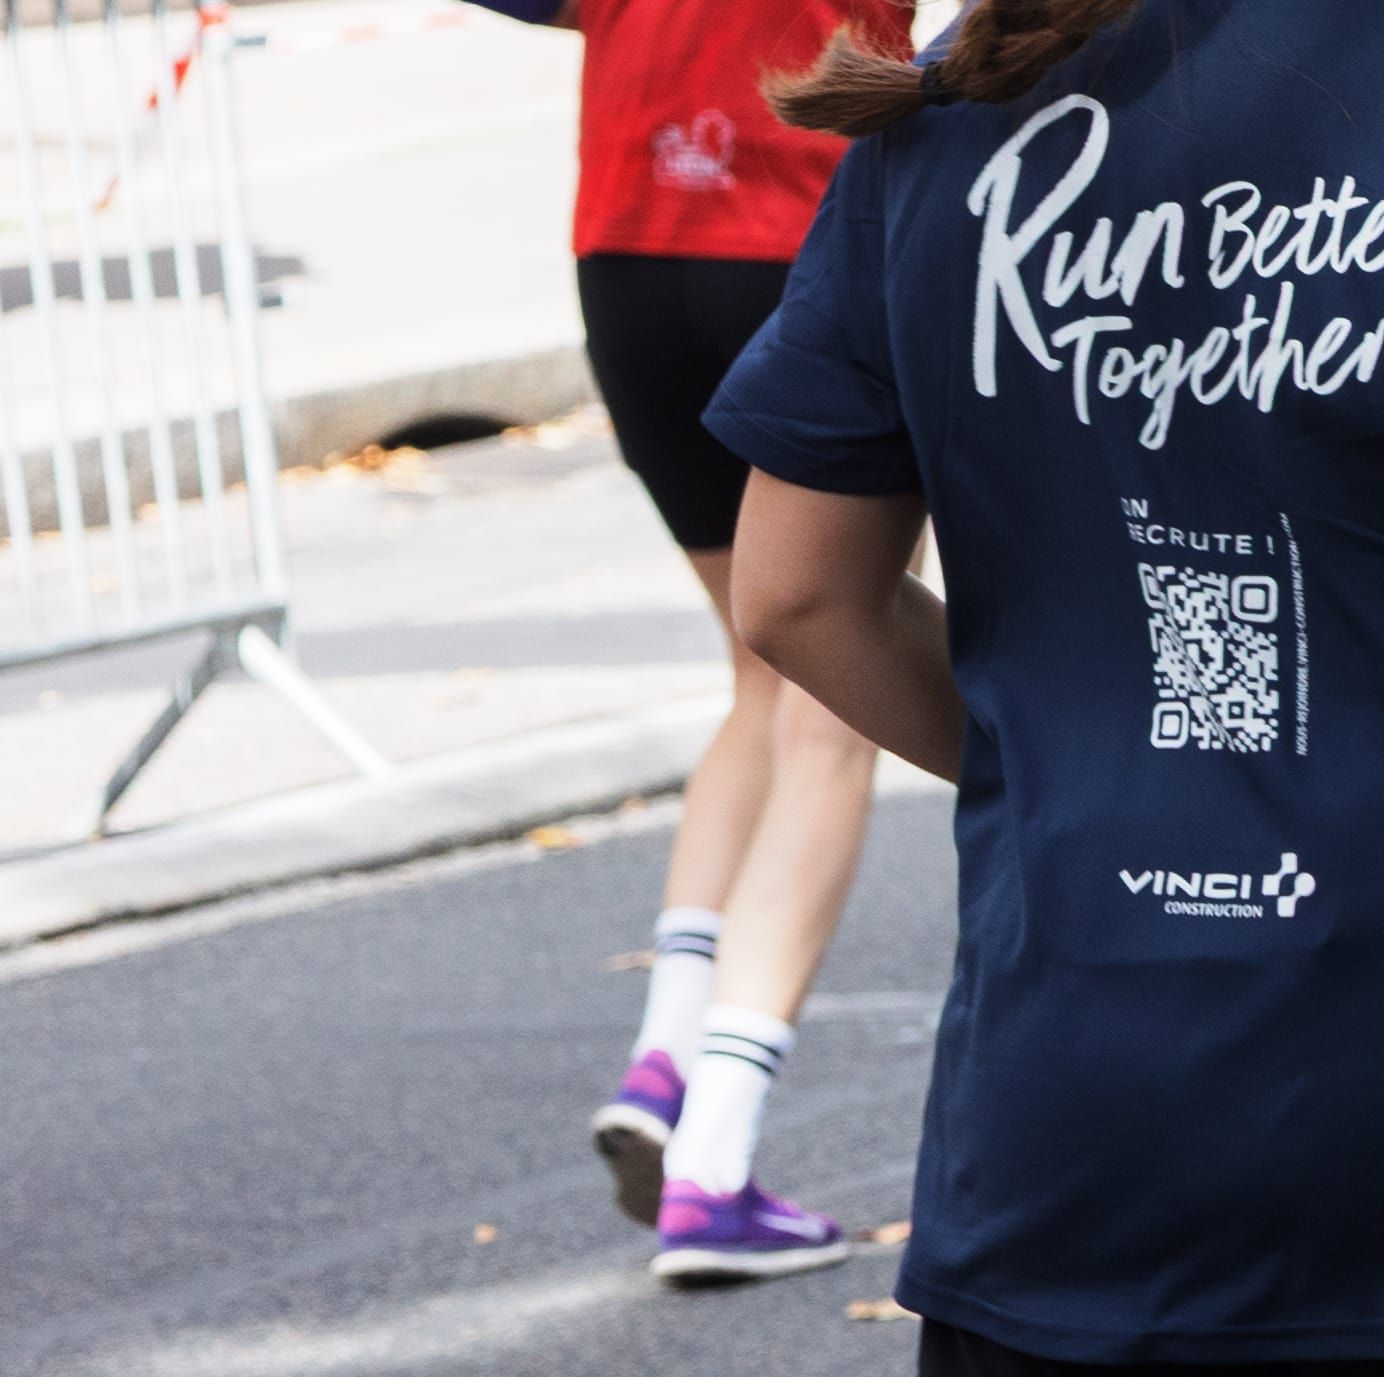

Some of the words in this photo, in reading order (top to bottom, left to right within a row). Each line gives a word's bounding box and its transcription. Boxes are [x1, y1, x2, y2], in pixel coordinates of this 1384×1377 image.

[966, 93, 1185, 398] Run
[1118, 868, 1252, 900] VINCI
[1163, 900, 1264, 918] CONSTRUCTION
